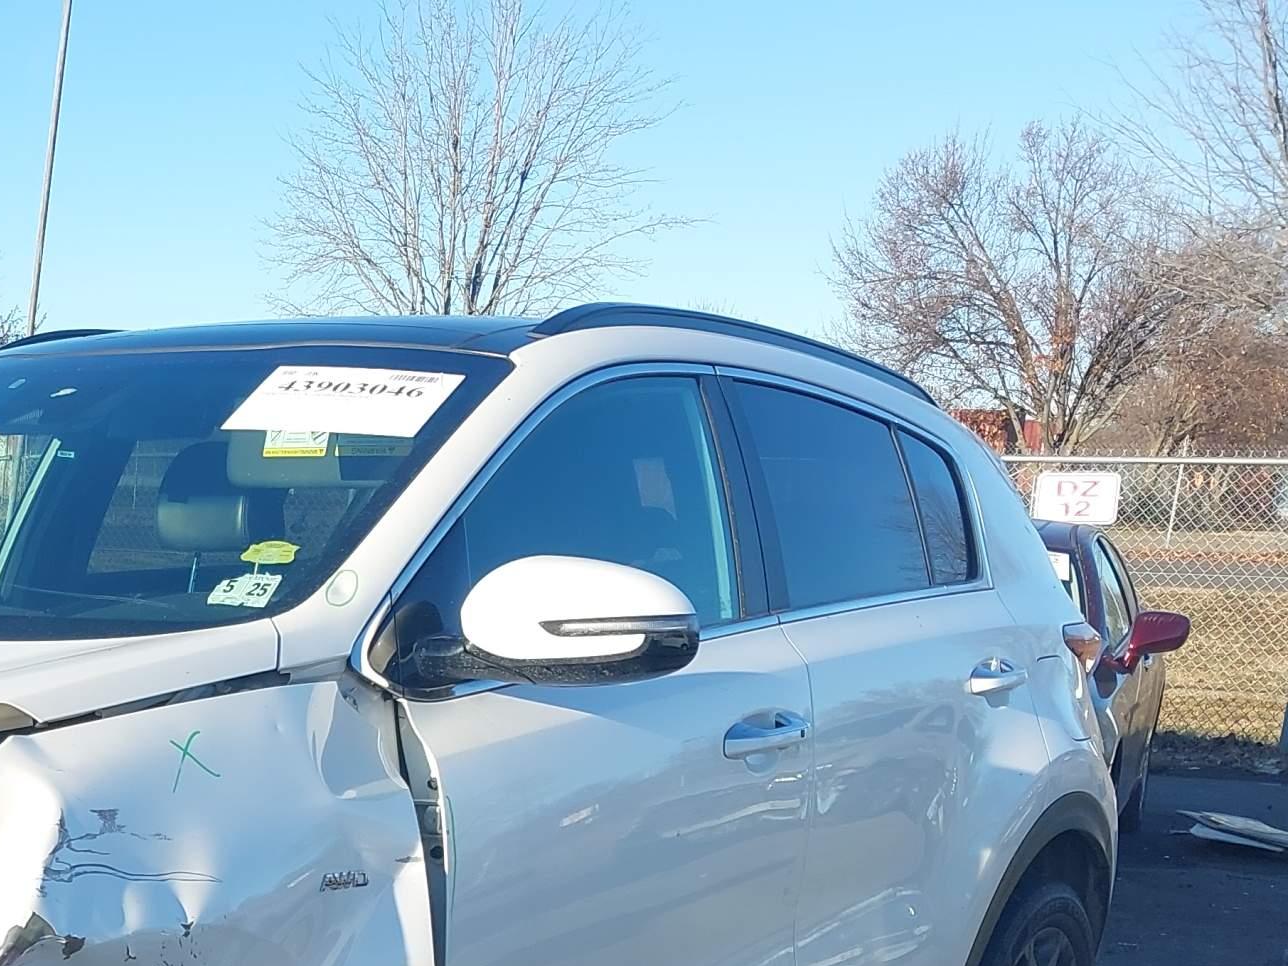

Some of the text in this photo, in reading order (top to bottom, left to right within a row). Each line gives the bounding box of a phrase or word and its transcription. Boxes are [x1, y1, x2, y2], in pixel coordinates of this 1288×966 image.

[278, 379, 425, 398] 43903046
[1056, 480, 1101, 497] DZ
[1060, 501, 1091, 517] 12
[223, 580, 272, 597] 5 25
[320, 871, 369, 892] AWD
